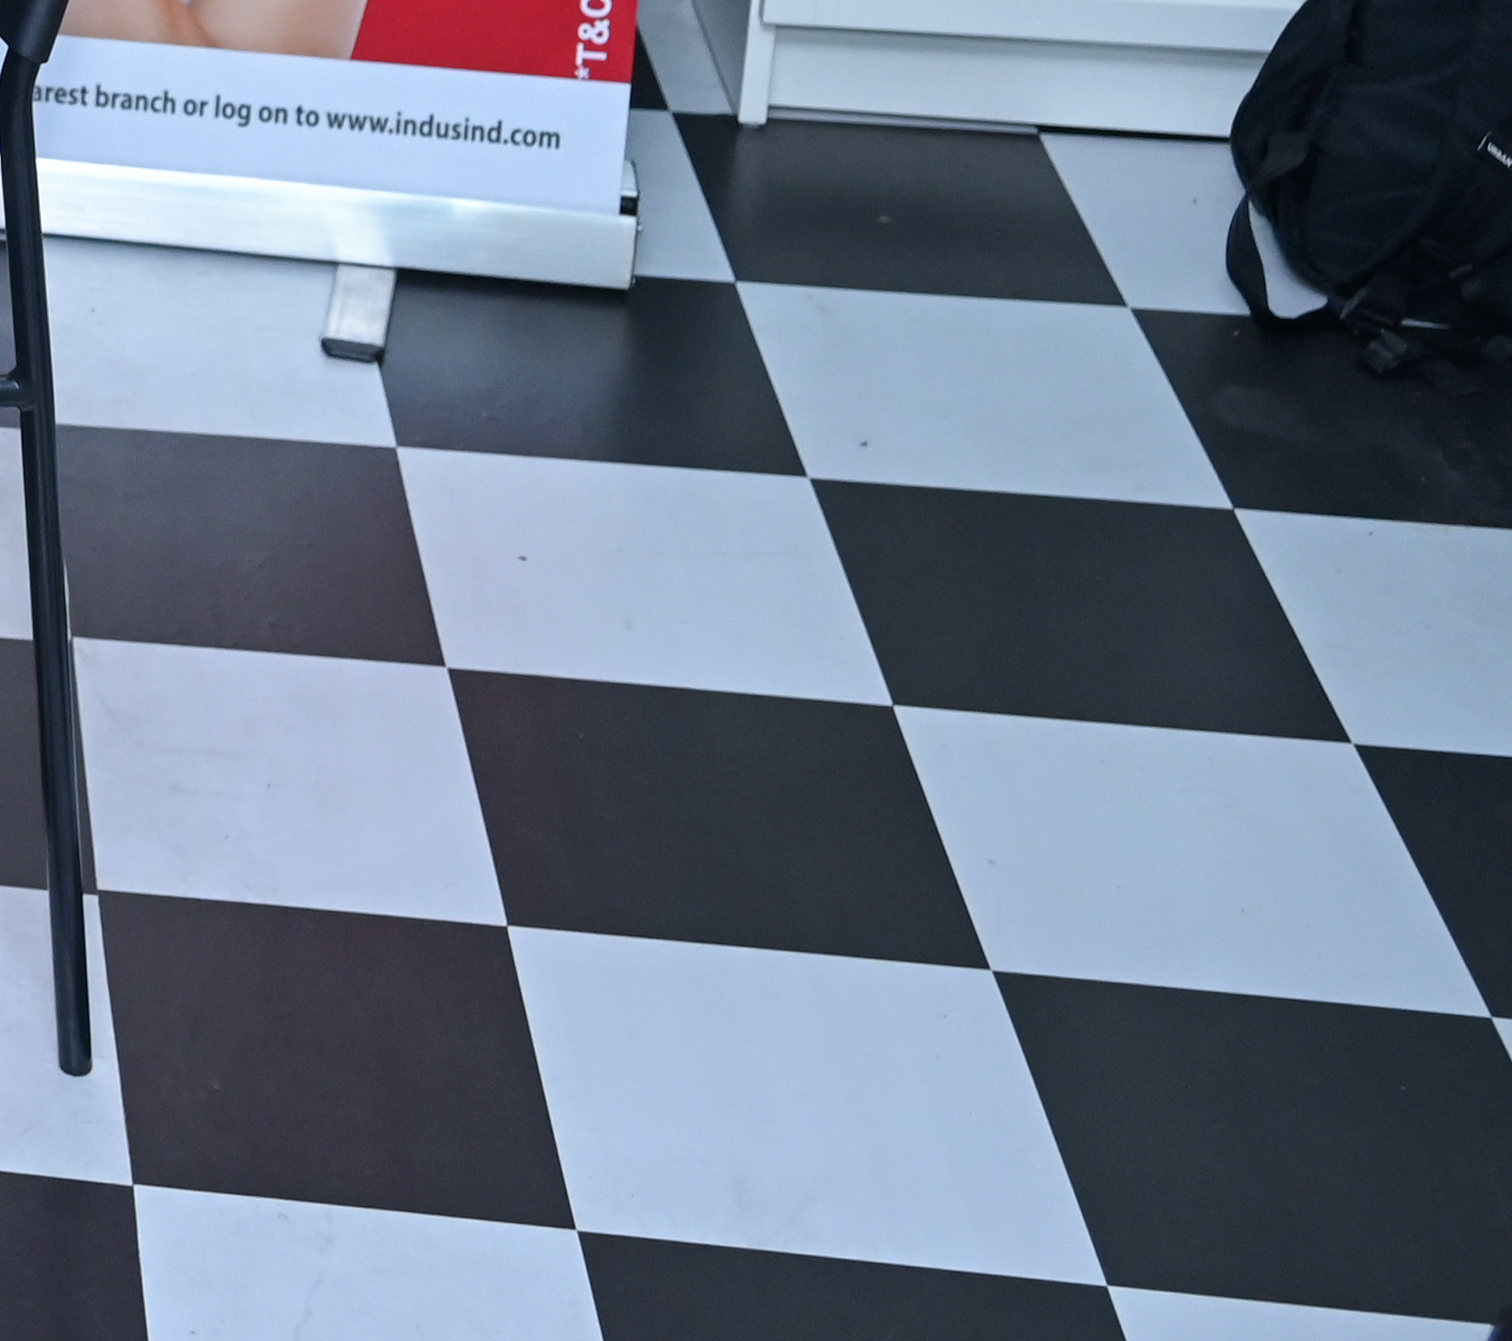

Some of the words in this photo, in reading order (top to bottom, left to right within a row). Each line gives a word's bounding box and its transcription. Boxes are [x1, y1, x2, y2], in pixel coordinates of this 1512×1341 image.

[31, 82, 89, 107] arest
[94, 83, 177, 116] branch
[182, 96, 209, 117] or
[214, 94, 252, 128] log
[258, 102, 289, 125] on
[295, 105, 321, 128] to
[326, 108, 561, 151] www.indusind.com
